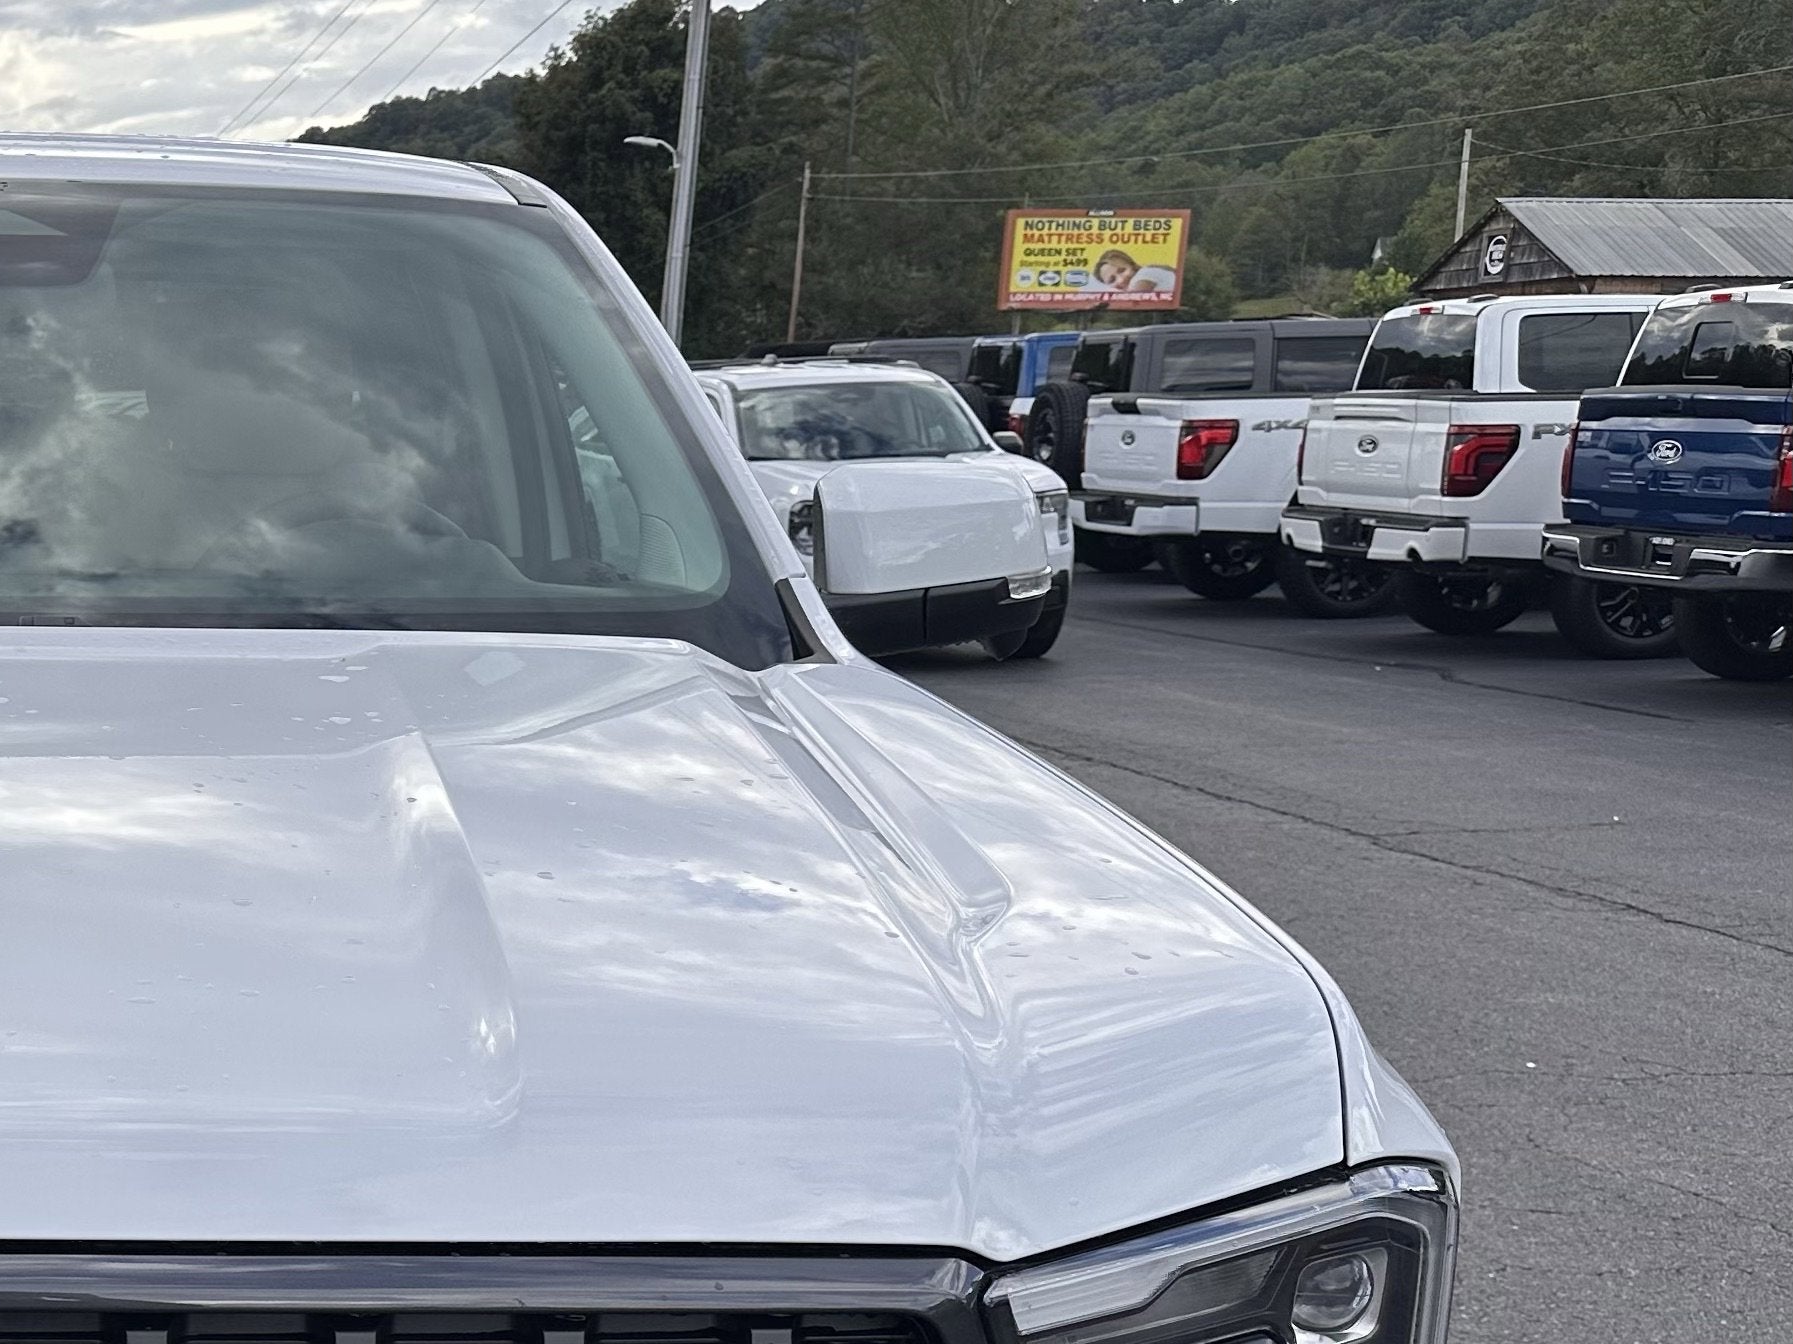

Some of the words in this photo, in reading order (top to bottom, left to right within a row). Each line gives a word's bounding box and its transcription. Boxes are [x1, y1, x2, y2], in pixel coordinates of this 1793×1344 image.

[1024, 220, 1093, 231] NOTHING
[1098, 220, 1128, 231] BUT
[1133, 220, 1172, 231] BEDS
[1023, 233, 1104, 244] MATTRESS
[1109, 233, 1171, 244] OUTLET
[1024, 248, 1063, 257] QUEEN
[1065, 248, 1086, 257] SET
[1009, 293, 1052, 302] LOCATED
[1600, 468, 1730, 496] F-150
